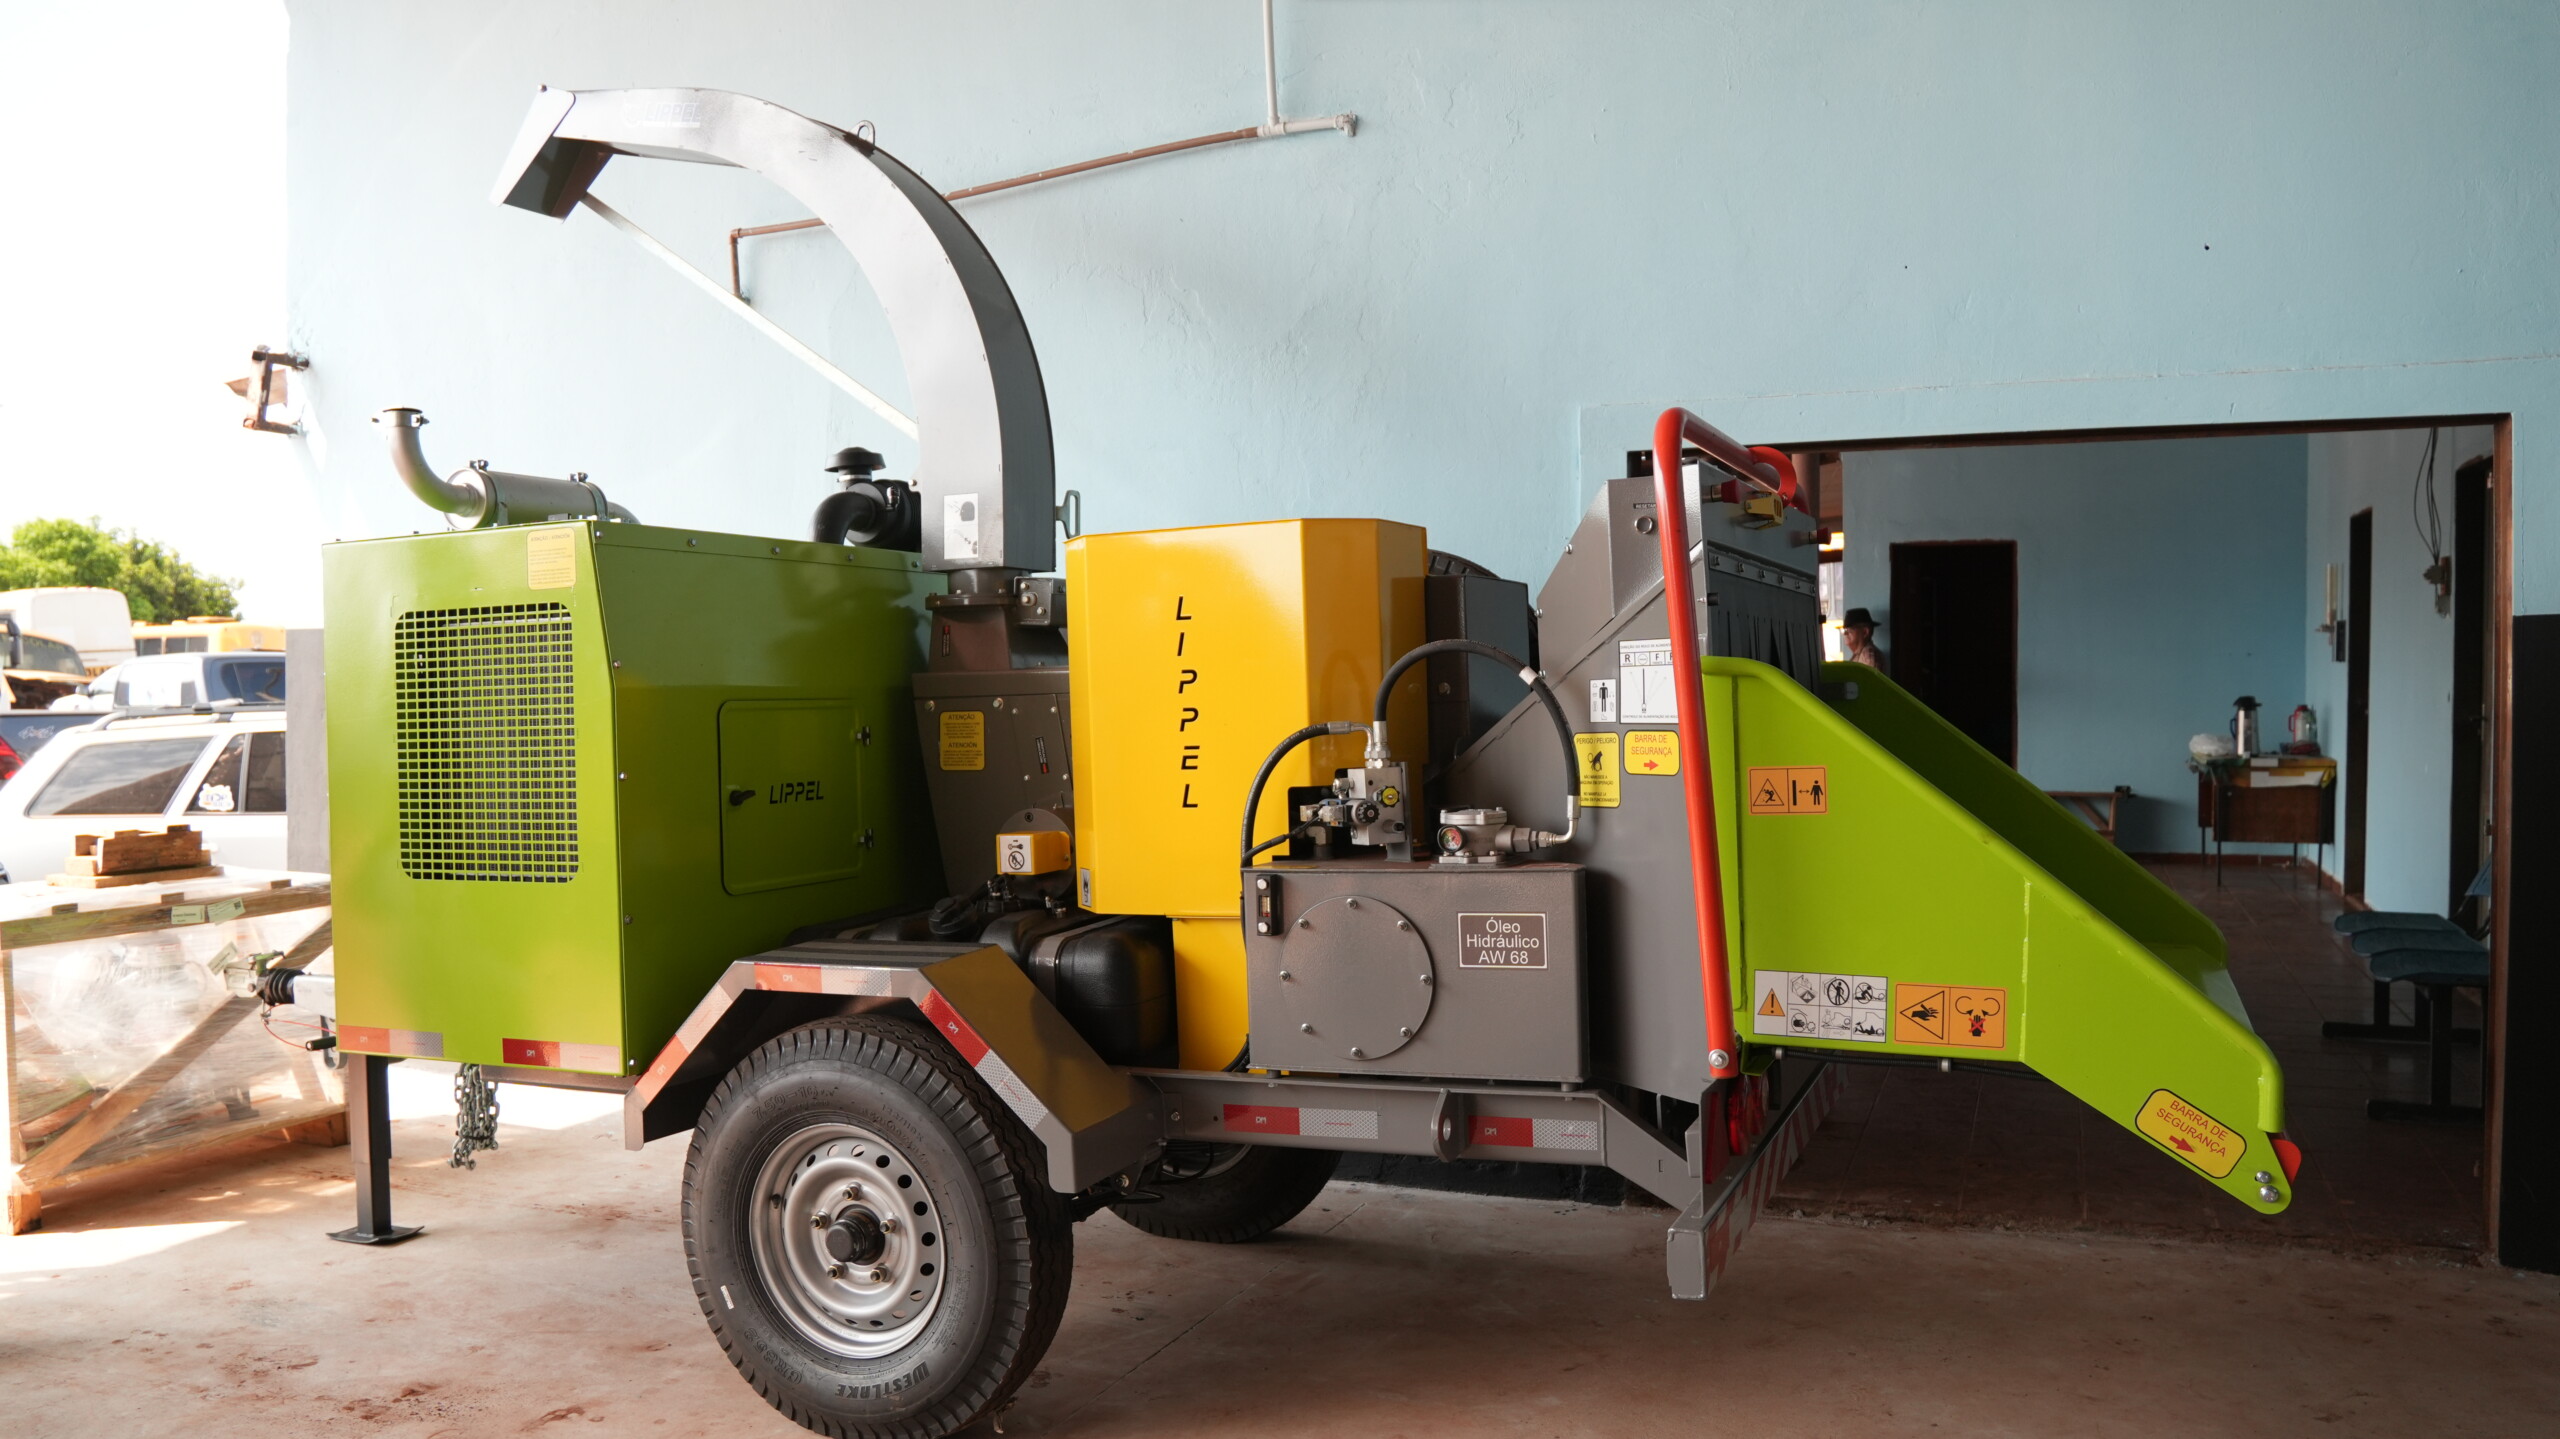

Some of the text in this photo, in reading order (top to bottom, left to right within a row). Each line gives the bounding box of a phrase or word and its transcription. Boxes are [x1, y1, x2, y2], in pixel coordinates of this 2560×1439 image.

[1625, 654, 1630, 662] R
[1176, 596, 1200, 808] LIPPEL
[1635, 734, 1667, 743] BARRA DE
[1631, 746, 1672, 757] SEGURANÇA
[769, 781, 824, 804] LIPPEL
[1486, 916, 1520, 933] Óleo
[1466, 934, 1540, 948] Hidráulico
[1478, 950, 1528, 964] AW 68
[2170, 1100, 2229, 1141] BARRA DE
[2157, 1108, 2226, 1157] SEGURANÇA
[835, 1361, 931, 1399] WESTLAKE
